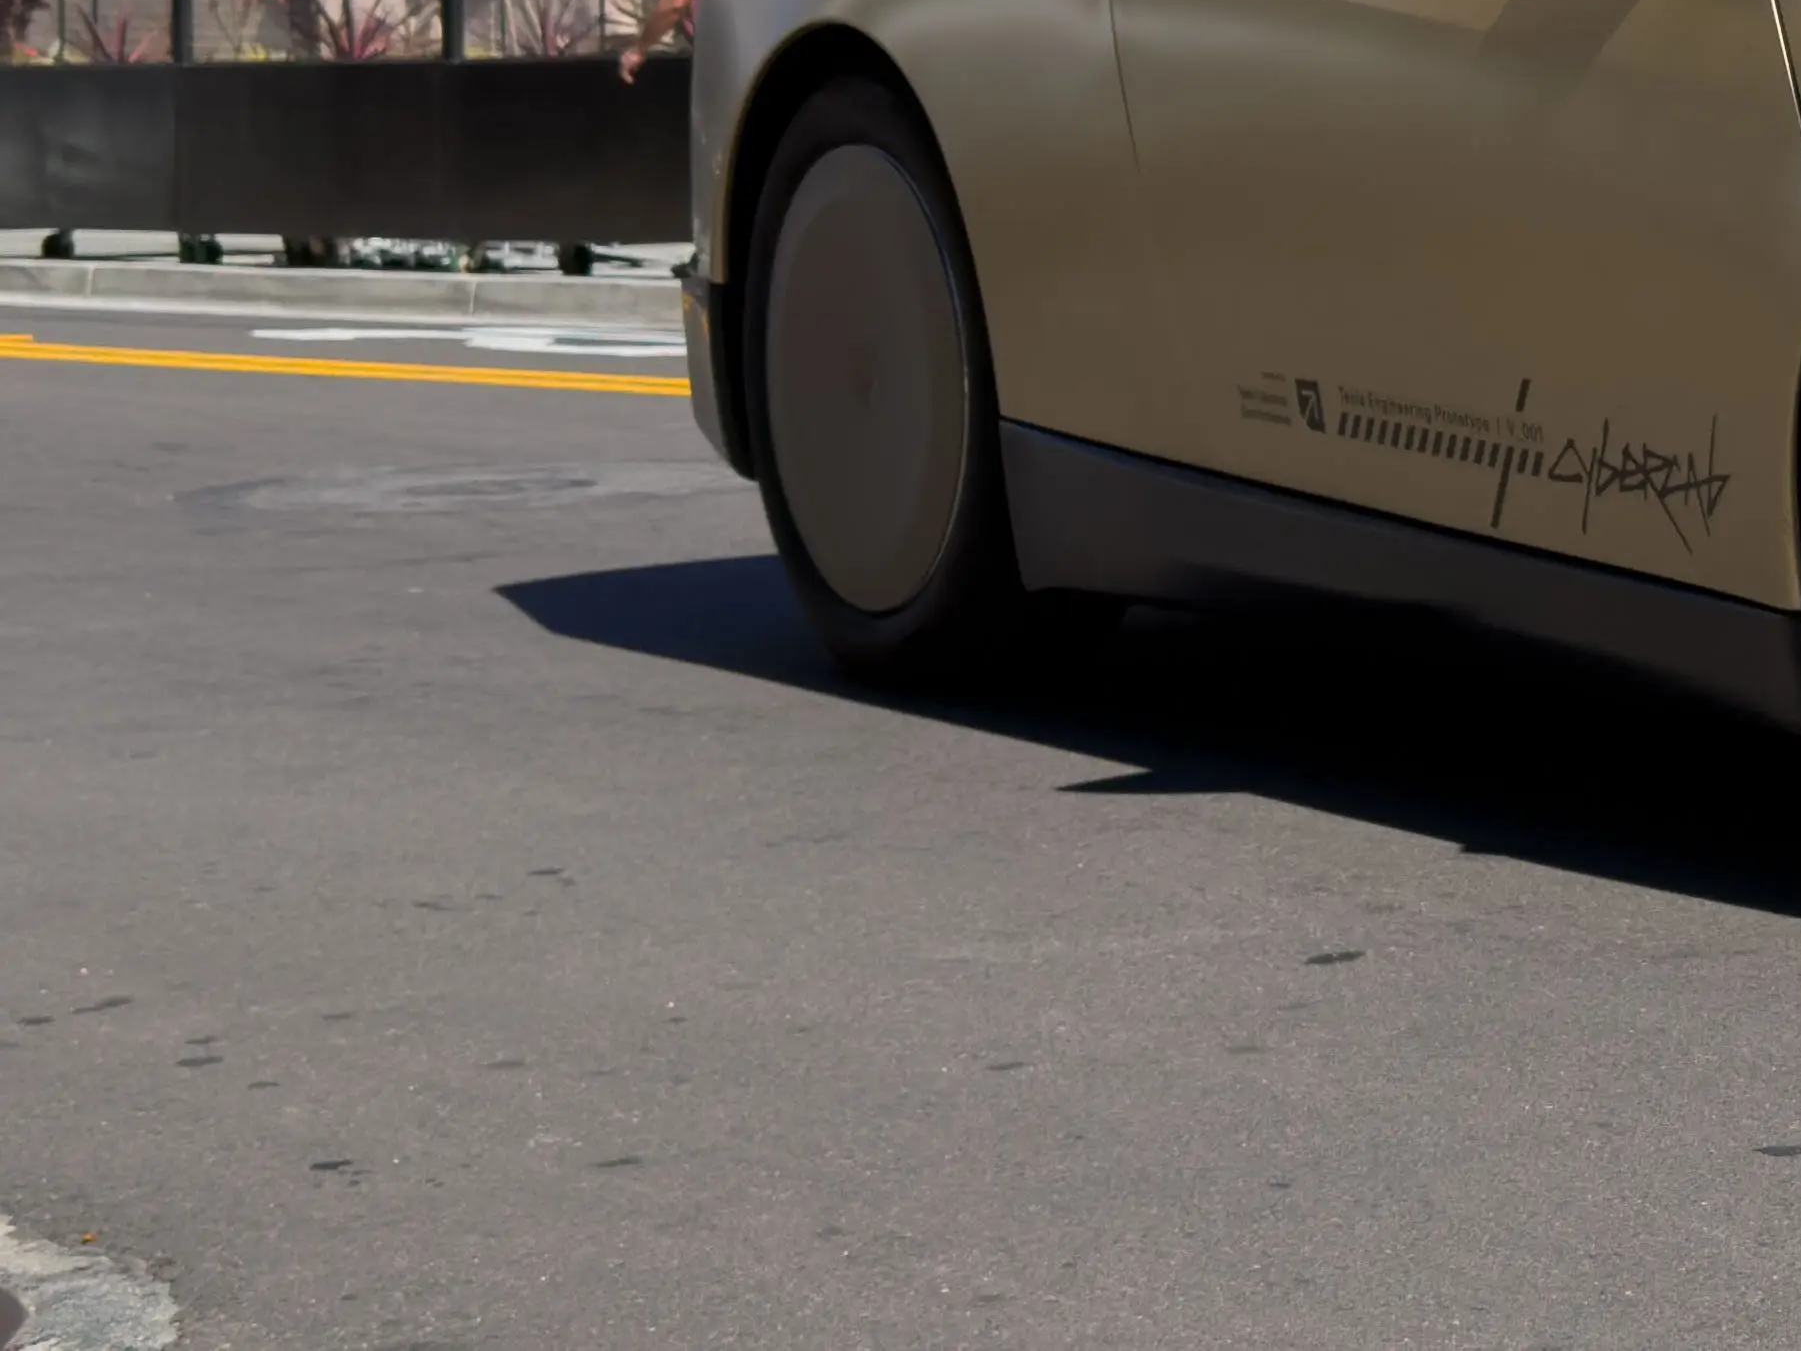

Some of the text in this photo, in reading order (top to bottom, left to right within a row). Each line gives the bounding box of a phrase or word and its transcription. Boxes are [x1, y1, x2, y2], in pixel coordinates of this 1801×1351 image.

[1337, 385, 1365, 407] Tesla
[1368, 391, 1432, 424] Engineering
[1434, 403, 1490, 434] Prototype
